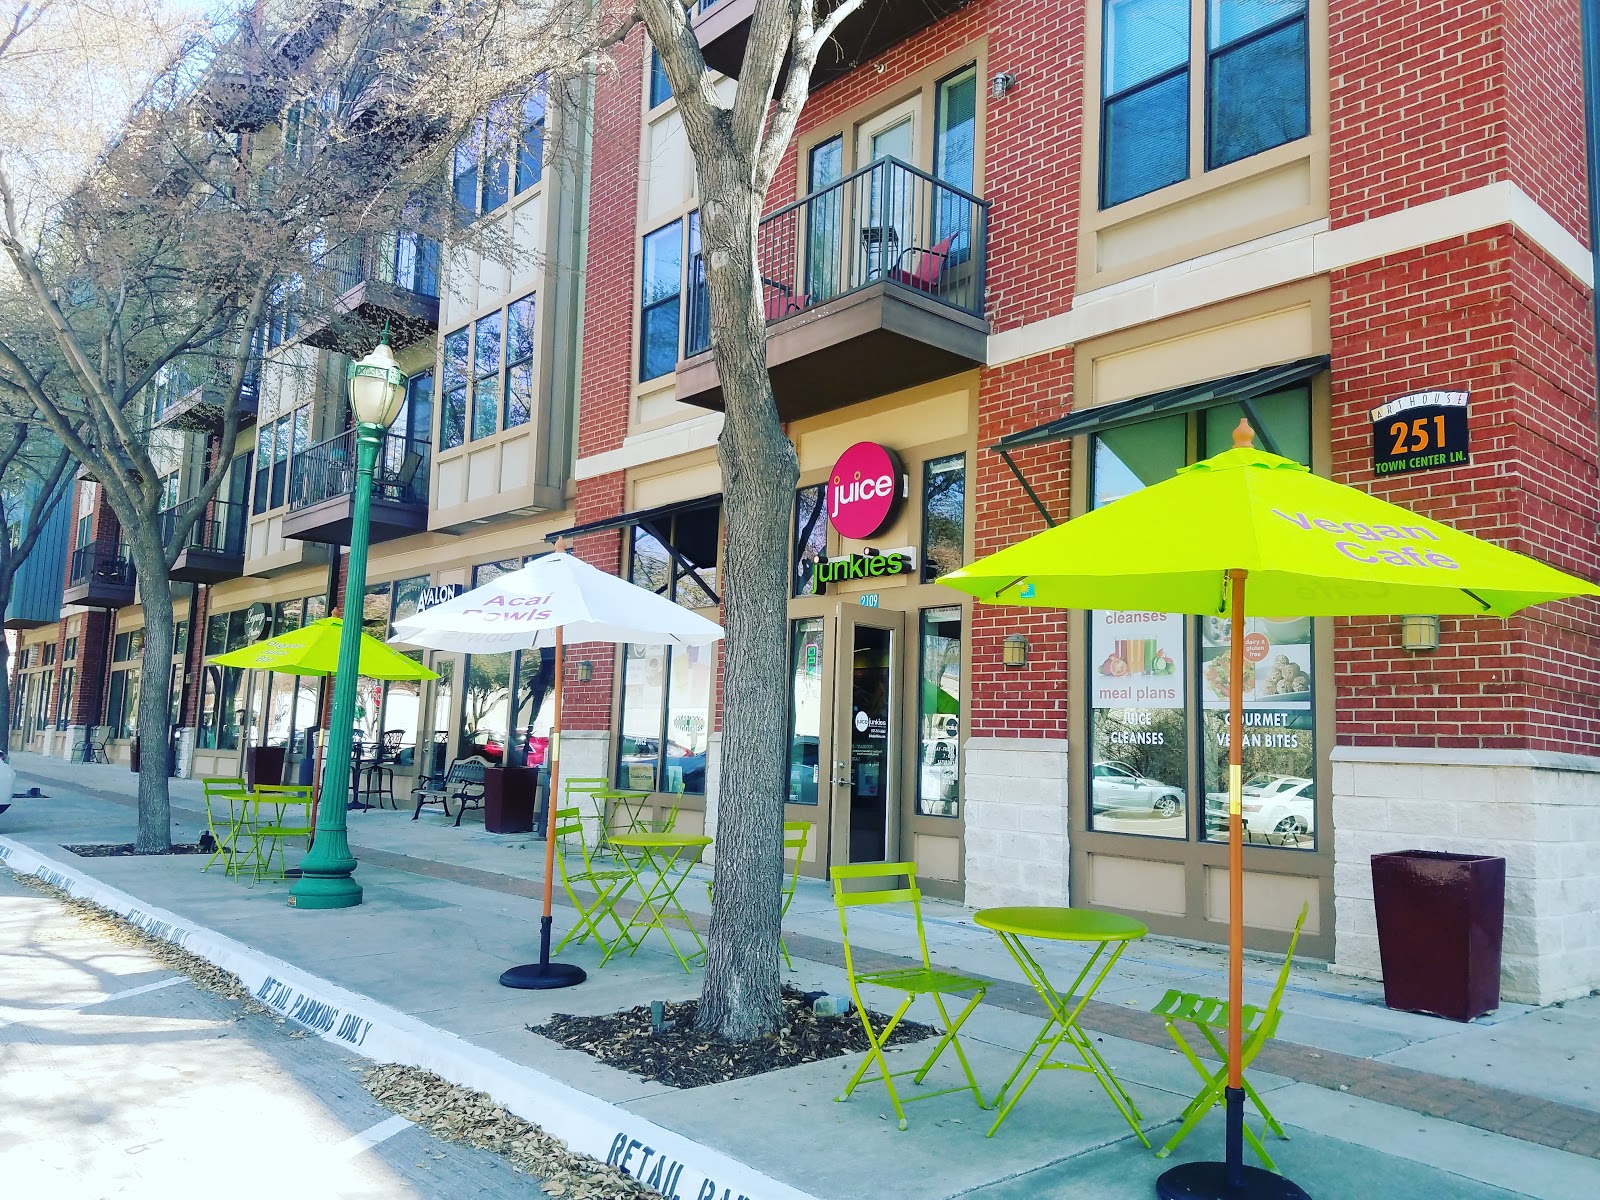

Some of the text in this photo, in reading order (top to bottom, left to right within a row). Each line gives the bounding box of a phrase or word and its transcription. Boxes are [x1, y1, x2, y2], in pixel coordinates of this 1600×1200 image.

[1377, 393, 1462, 418] ARTHOUSE
[1390, 415, 1446, 455] 251
[1376, 460, 1406, 474] TOWN
[1409, 453, 1446, 468] CENTER
[831, 471, 893, 518] juice
[1271, 508, 1440, 542] Vegan
[1334, 541, 1460, 569] Café
[811, 547, 903, 594] junkies
[416, 584, 456, 614] AVALON
[861, 594, 878, 607] 2109
[1105, 611, 1167, 624] cleanses
[1245, 644, 1265, 652] gluten
[1099, 686, 1176, 702] meal plans
[1124, 711, 1152, 725] JUICE
[1225, 712, 1288, 727] GURMET
[1111, 731, 1164, 745] CLEANSES
[1216, 732, 1298, 748] VEAN BITES
[256, 975, 374, 1047] RETAIL PARKING ONLY
[606, 1132, 685, 1200] RETAIL
